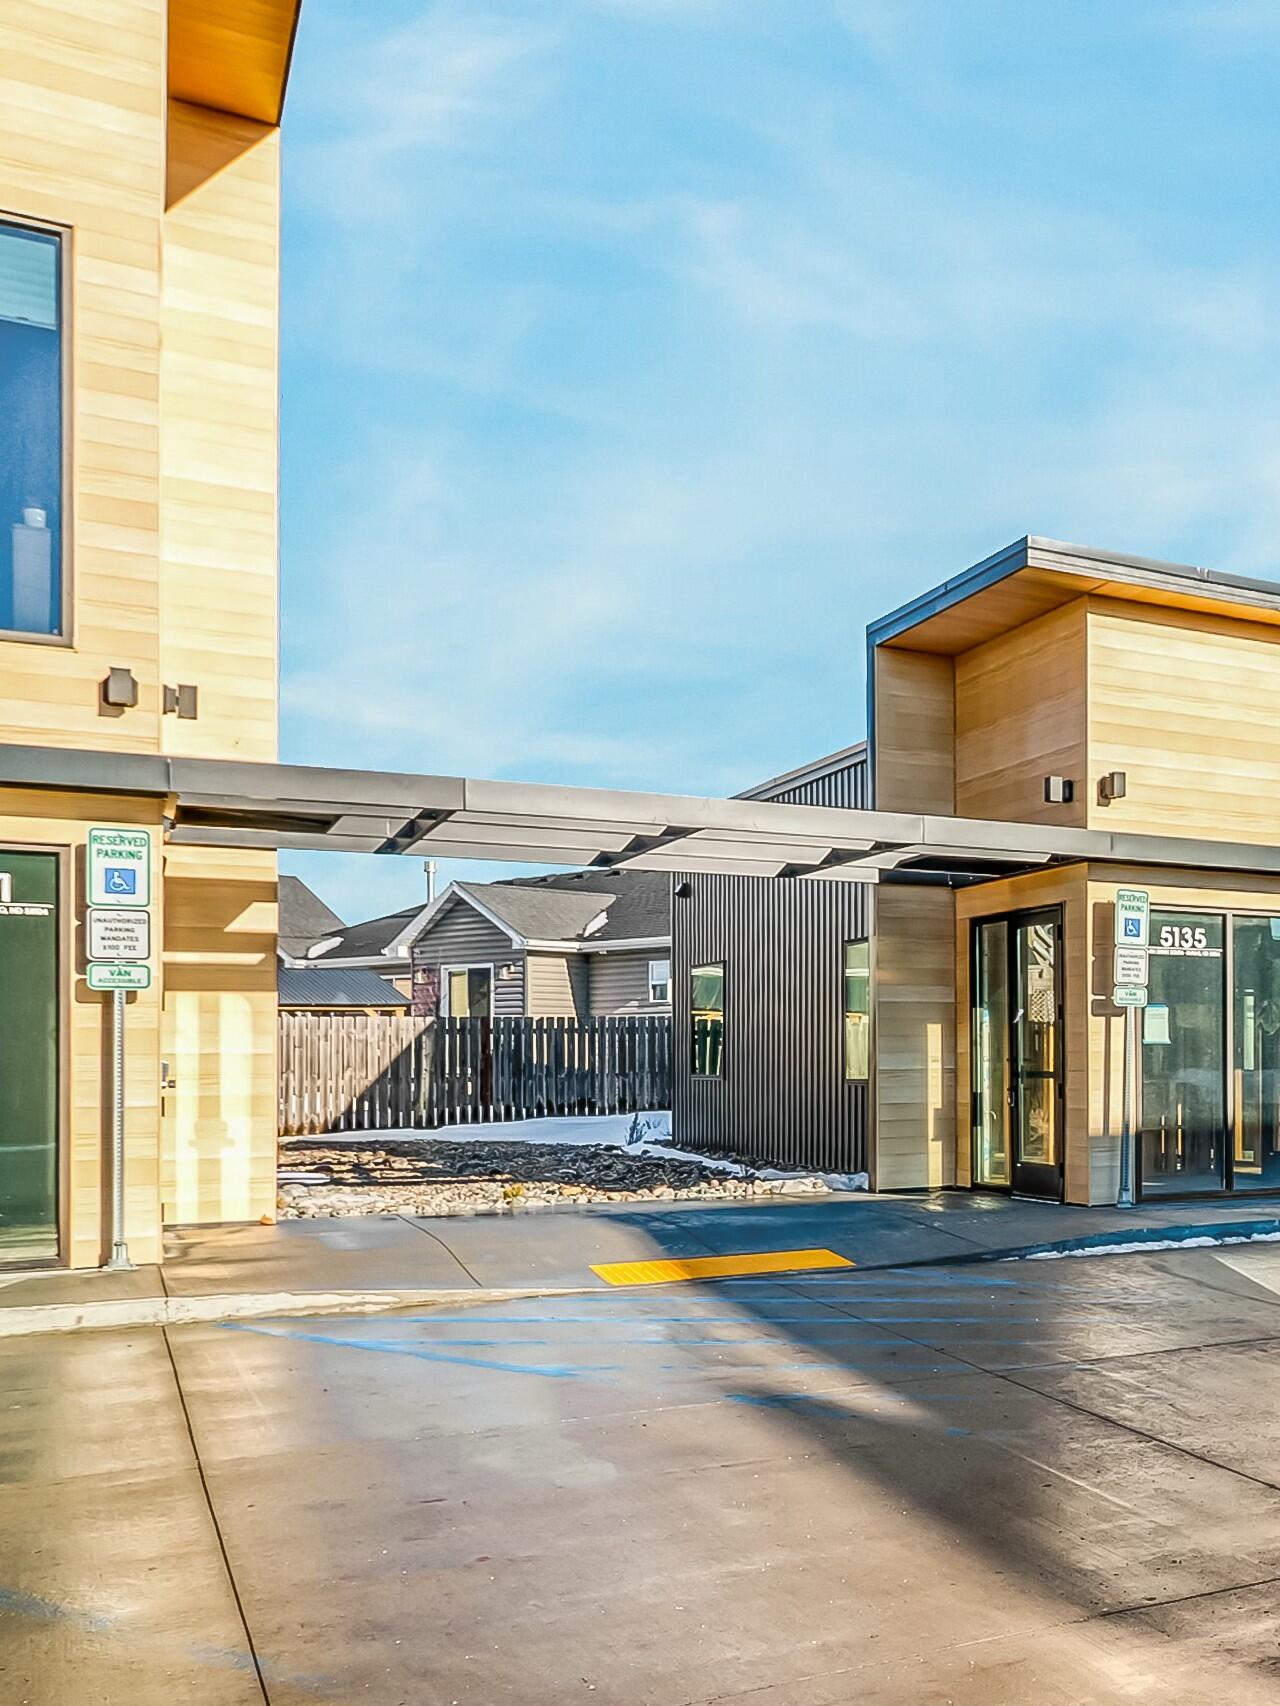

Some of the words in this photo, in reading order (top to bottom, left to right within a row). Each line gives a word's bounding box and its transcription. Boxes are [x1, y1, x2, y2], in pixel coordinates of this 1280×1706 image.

[92, 834, 147, 847] RESERVED
[96, 848, 143, 860] PARKING
[1121, 903, 1145, 912] PARKING
[1160, 926, 1207, 949] 5135
